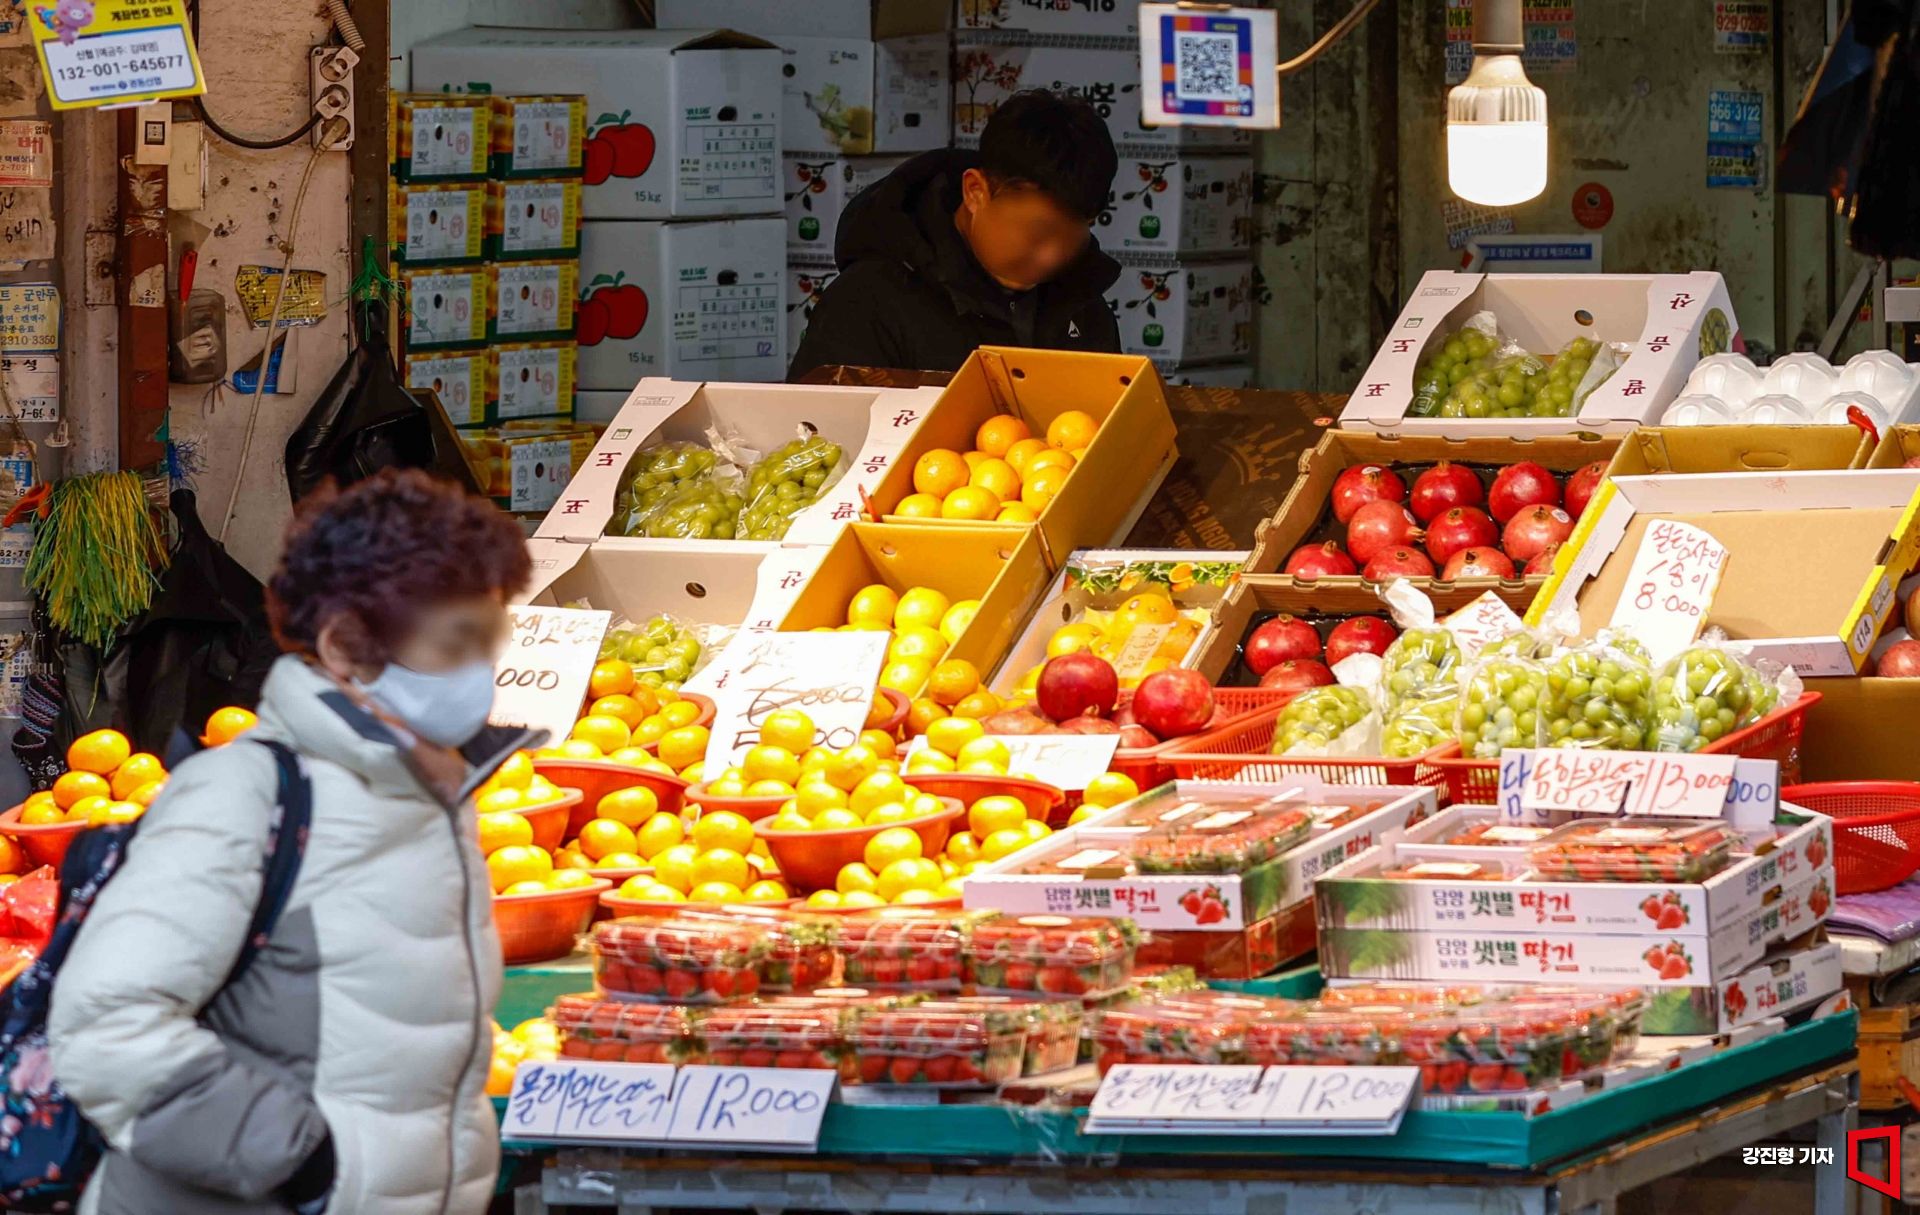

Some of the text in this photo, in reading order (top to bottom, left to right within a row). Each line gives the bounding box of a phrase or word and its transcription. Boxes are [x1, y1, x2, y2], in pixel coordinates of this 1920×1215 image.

[57, 54, 185, 81] 132-001-645677
[1432, 888, 1571, 923] 담양 샛별 딸기
[1436, 938, 1575, 973] 담양 샛별 딸기
[697, 1072, 820, 1131] 12.000
